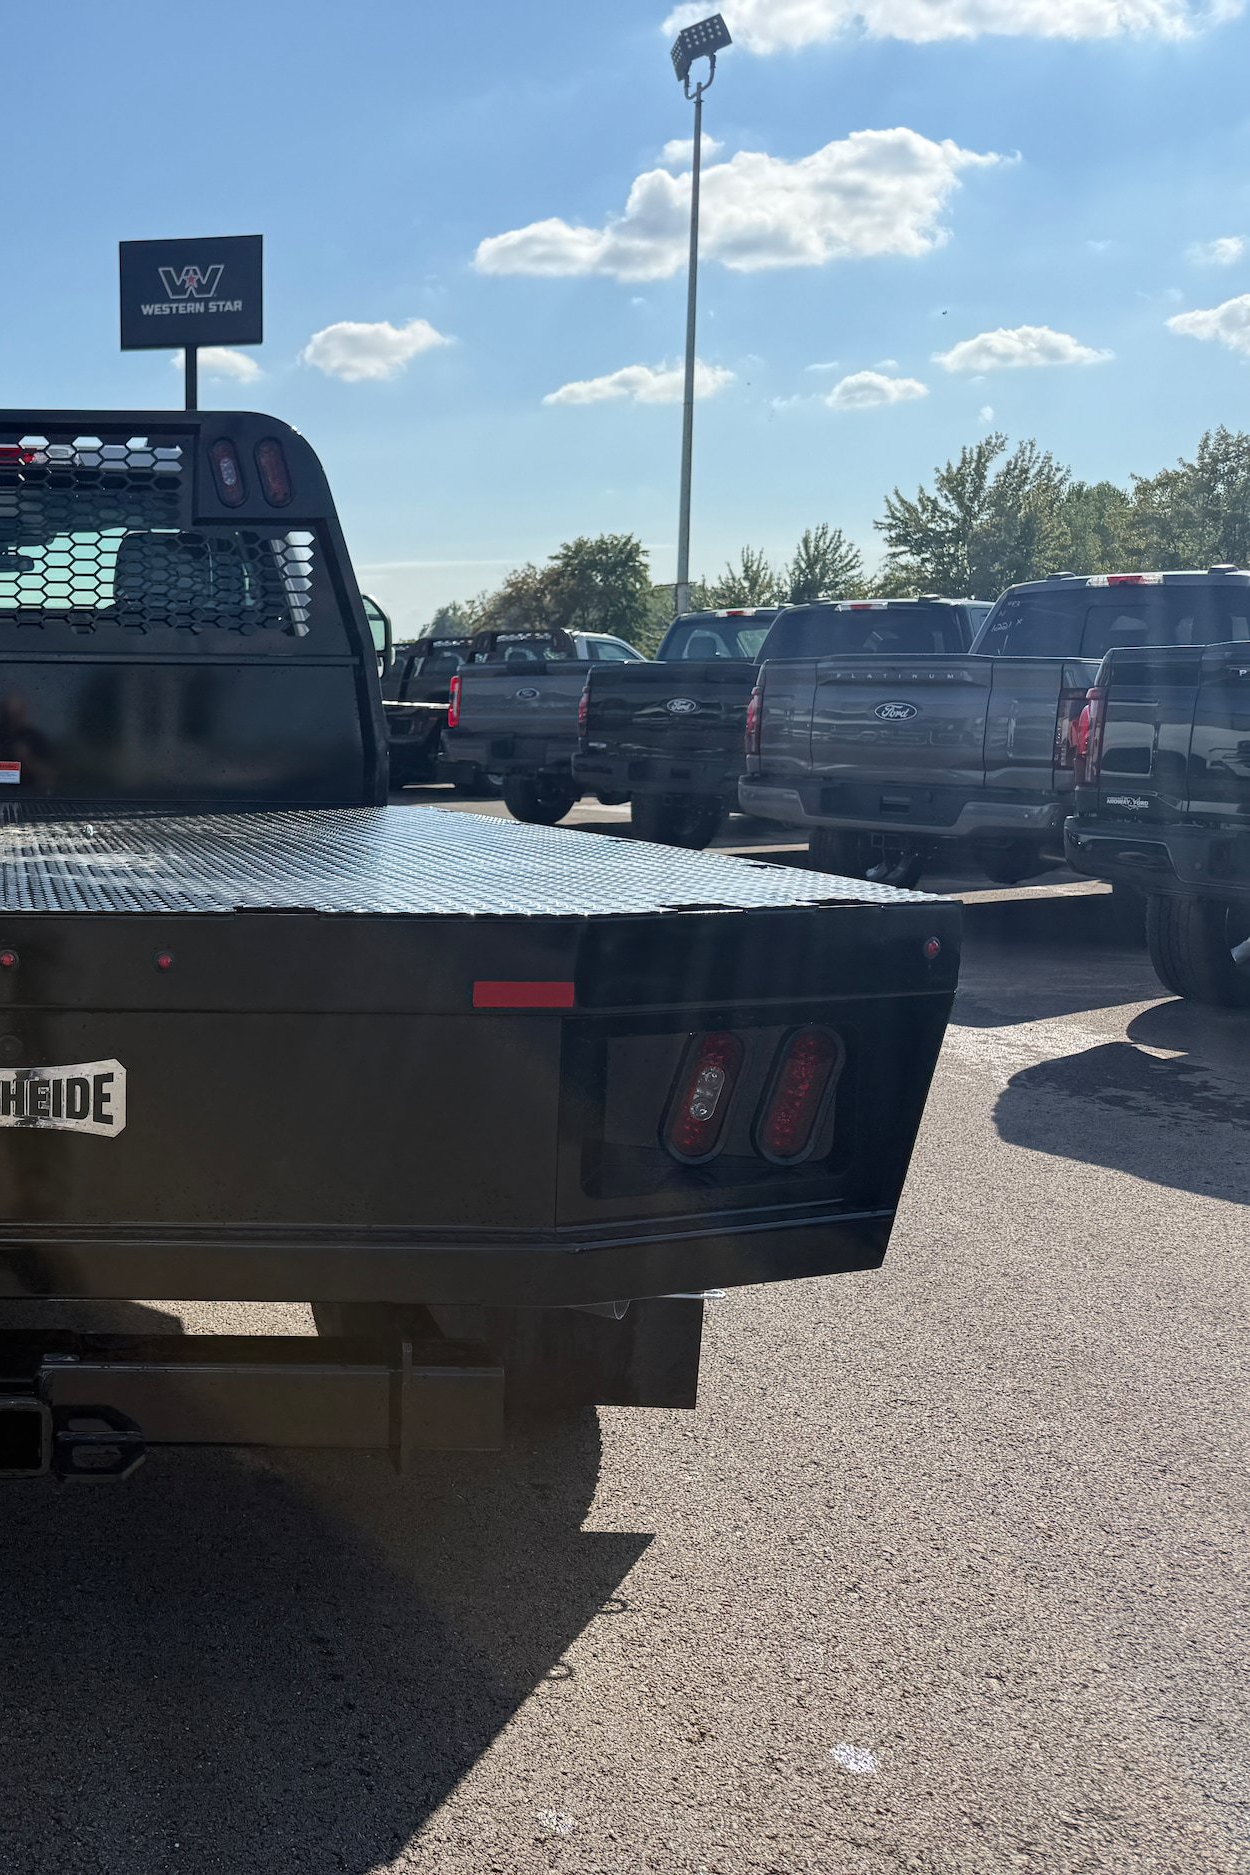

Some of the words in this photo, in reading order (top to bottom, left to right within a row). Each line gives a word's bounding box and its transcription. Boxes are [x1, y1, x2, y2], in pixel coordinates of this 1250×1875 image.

[141, 303, 204, 315] WESTERN
[208, 300, 242, 312] STAR
[881, 704, 910, 718] Ford
